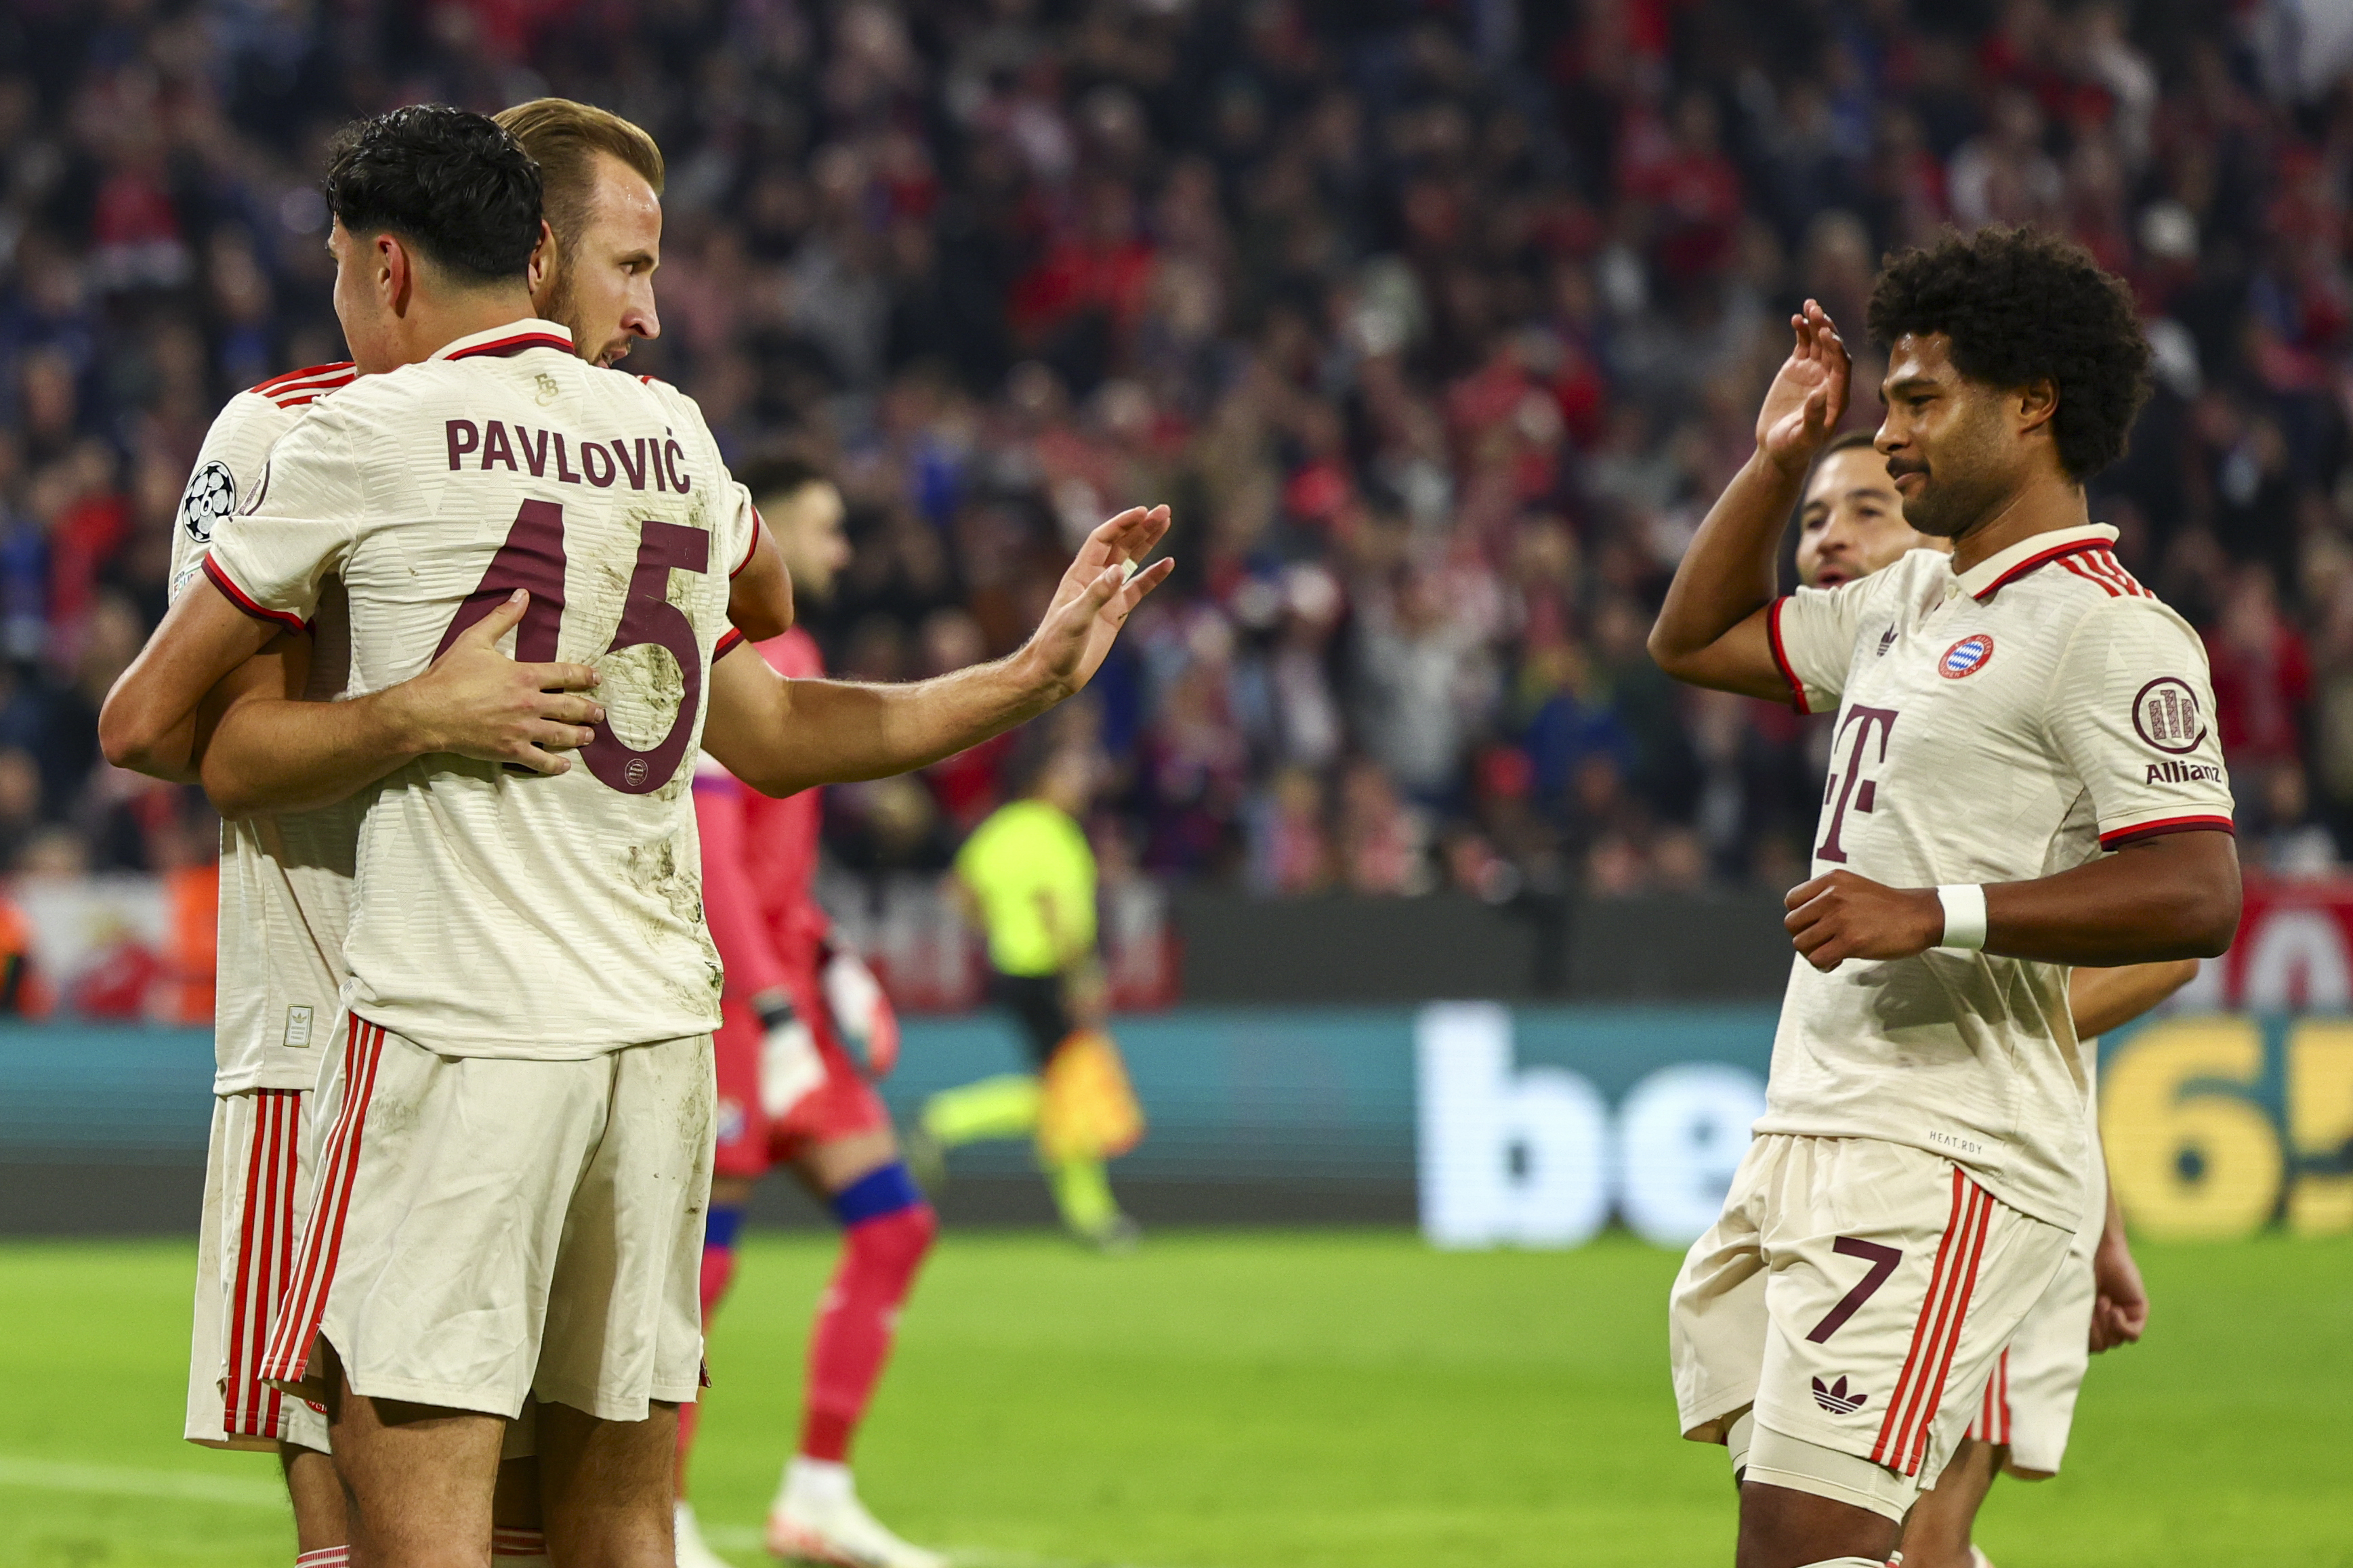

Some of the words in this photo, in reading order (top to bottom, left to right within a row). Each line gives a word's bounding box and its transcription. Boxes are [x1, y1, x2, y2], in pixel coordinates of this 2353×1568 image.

[445, 419, 691, 494] PAVLOVIĆ
[199, 486, 213, 517] 6
[2145, 759, 2222, 785] Allianz
[1929, 1130, 1982, 1155] HEAT.RDY
[1805, 1235, 1903, 1344] 7
